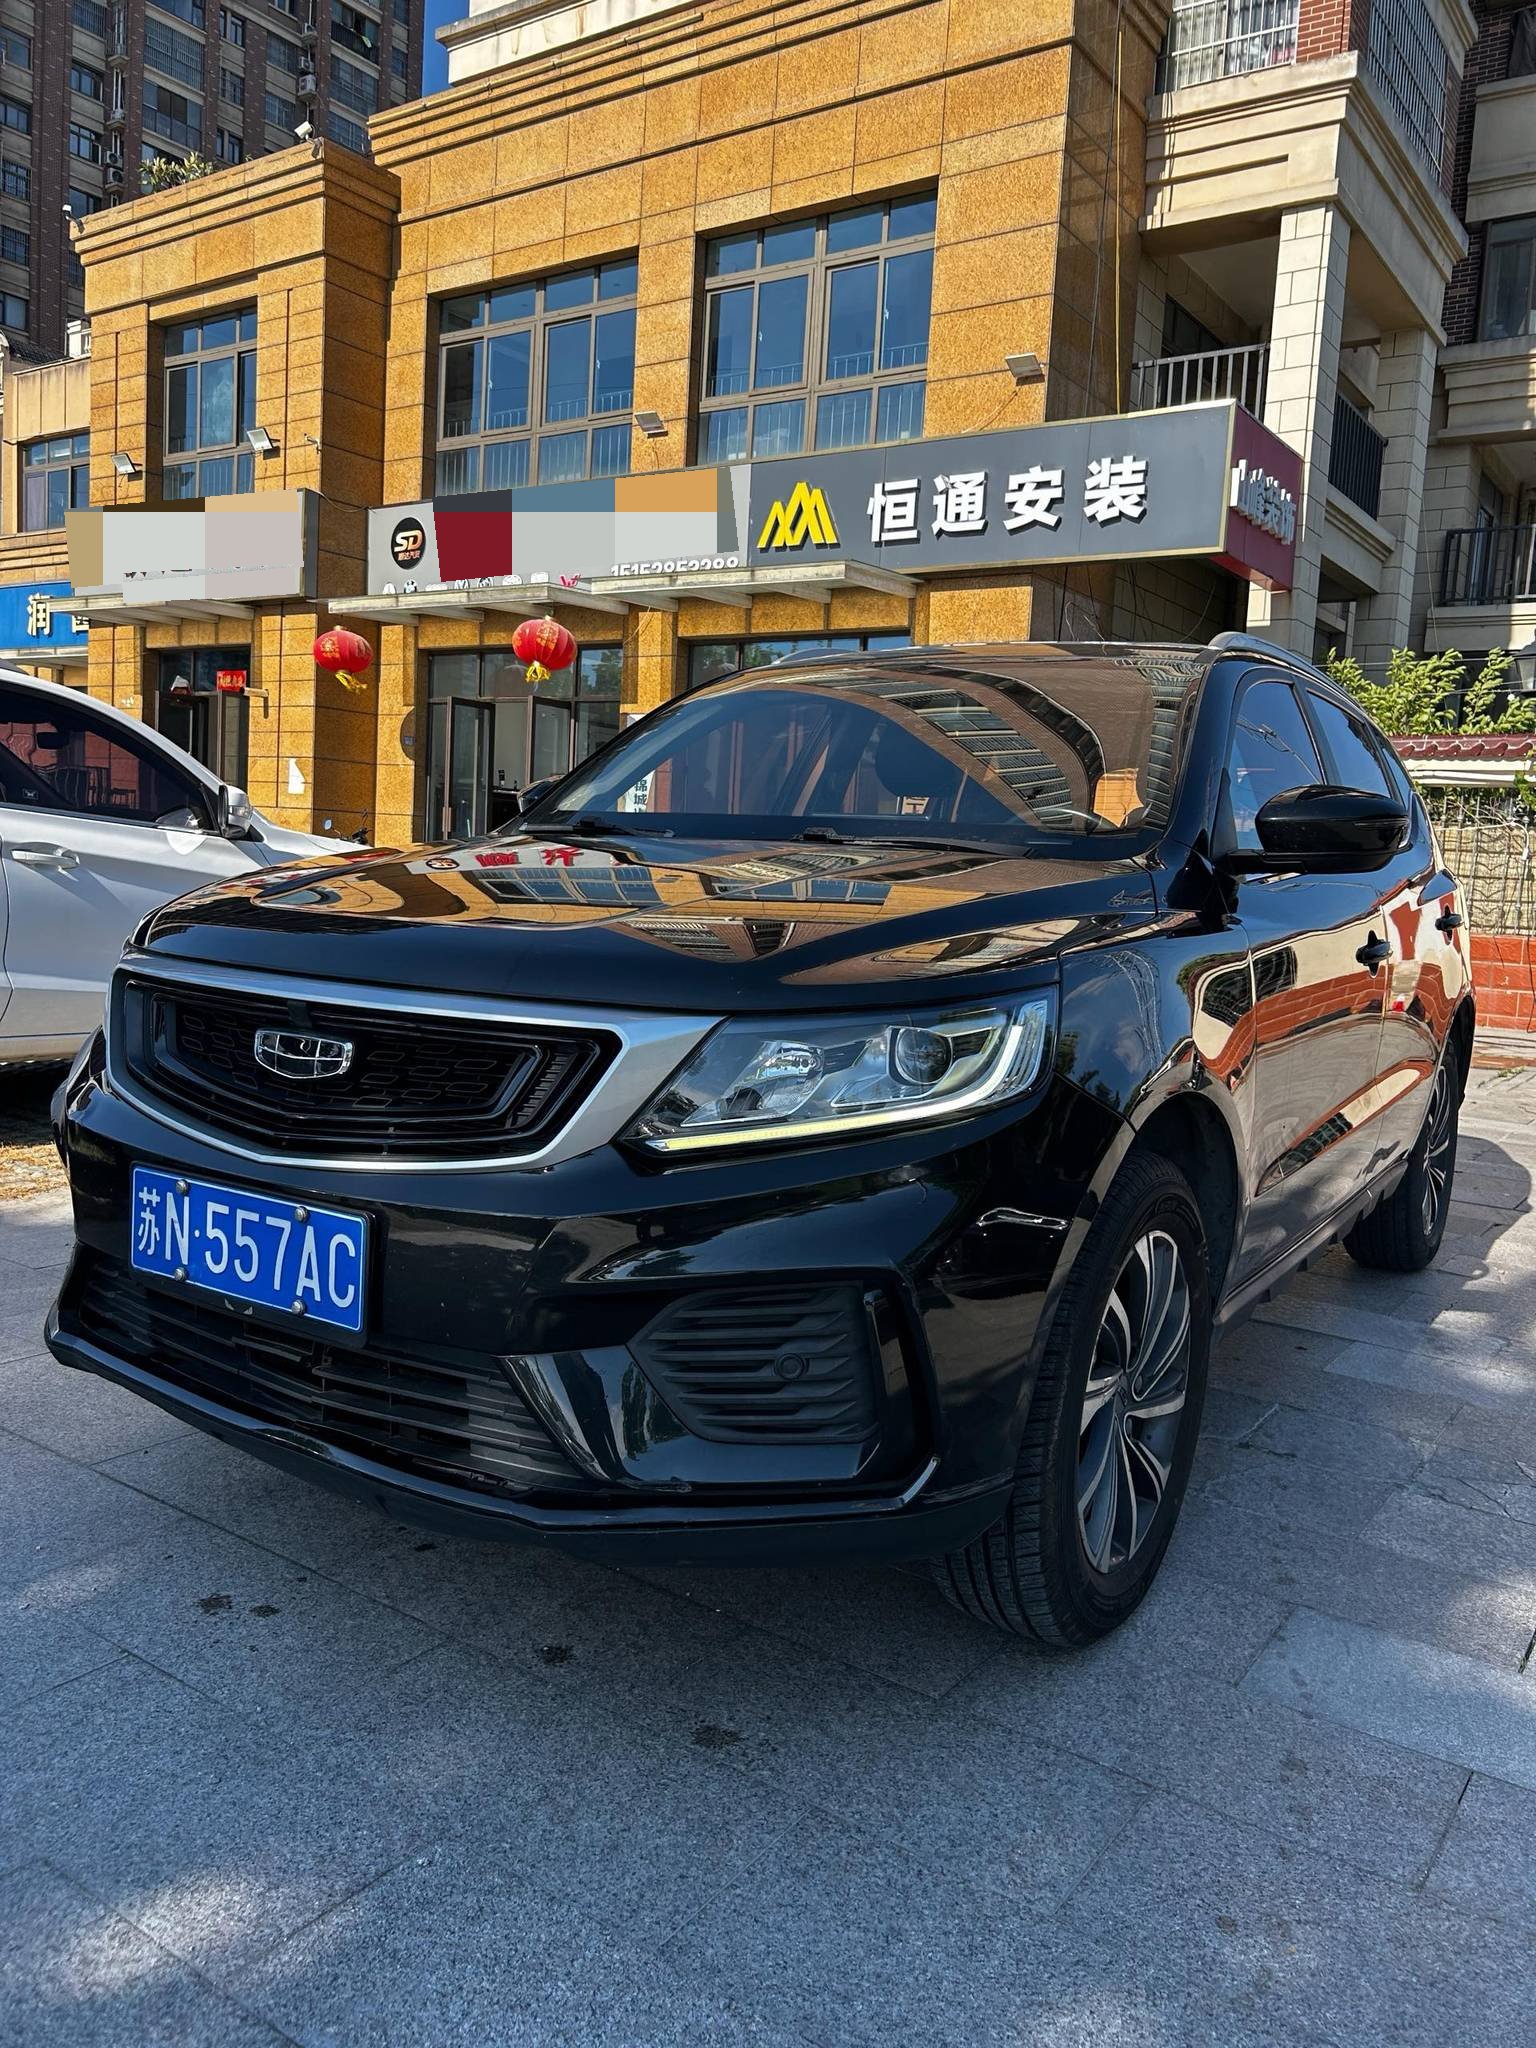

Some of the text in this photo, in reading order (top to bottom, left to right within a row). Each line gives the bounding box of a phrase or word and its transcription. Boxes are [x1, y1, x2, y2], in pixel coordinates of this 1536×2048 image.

[394, 529, 423, 552] SD
[866, 455, 1148, 544] 恒通安装
[138, 1186, 356, 1309] 苏N·557AC
